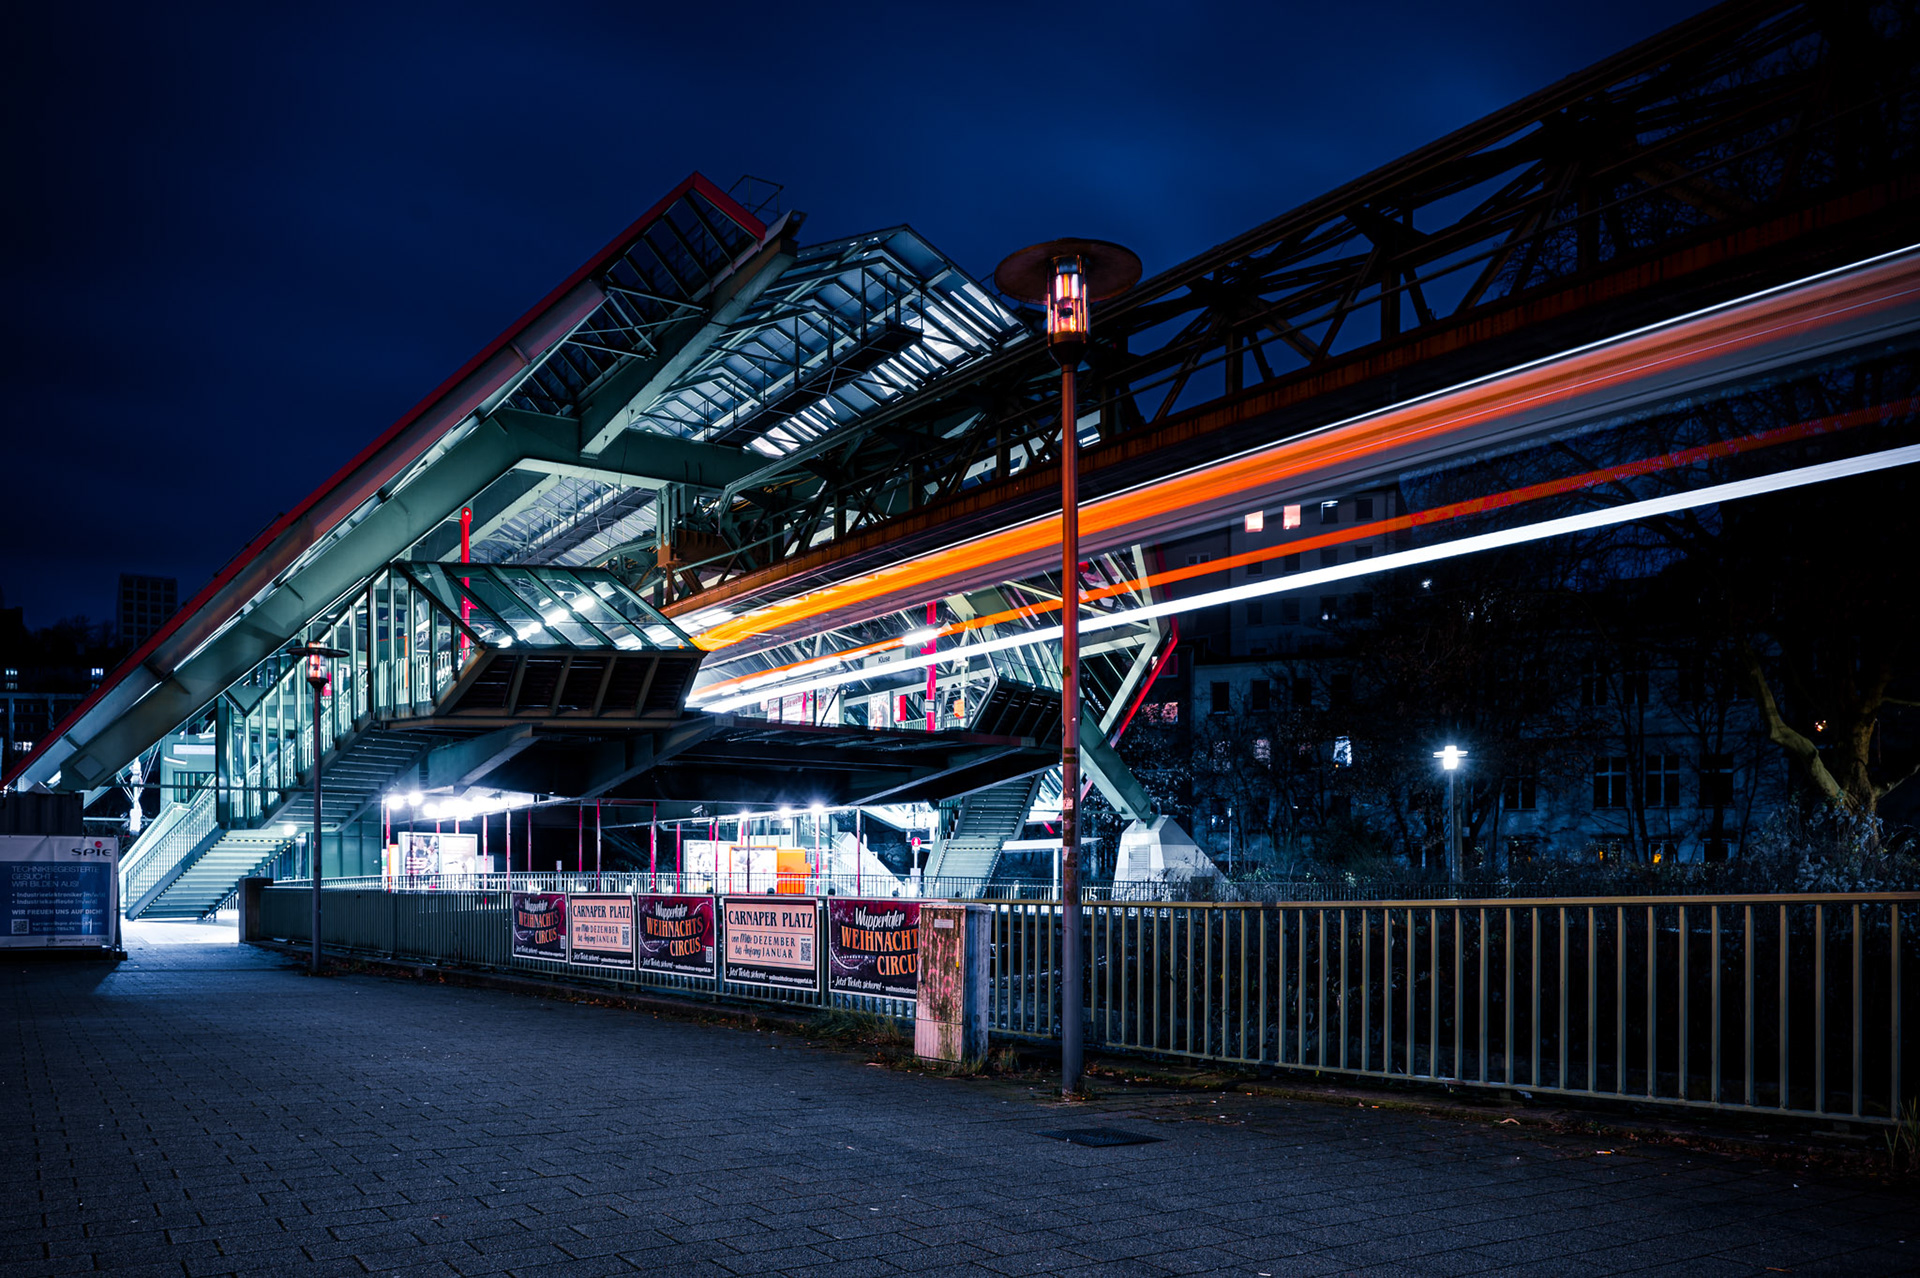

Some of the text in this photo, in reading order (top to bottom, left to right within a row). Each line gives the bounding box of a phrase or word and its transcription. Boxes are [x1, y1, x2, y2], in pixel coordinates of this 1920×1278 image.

[878, 655, 891, 663] Kluse
[72, 847, 112, 857] SPIE
[573, 905, 631, 919] CARNAPER PLATZ
[655, 900, 688, 920] Wuppertaler
[855, 906, 905, 931] Wuppertaler
[518, 910, 559, 928] WEIHNACHTS
[646, 916, 704, 938] WEIHNACHTS
[728, 910, 813, 928] CARNAPER PLATZ
[535, 928, 558, 945] CIRCUS
[590, 925, 619, 934] DEZEMBER
[841, 924, 919, 952] WEIHNACHT
[596, 934, 618, 944] JANUAR
[669, 936, 702, 957] CIRCUS
[753, 935, 796, 947] DEZEMBER
[762, 947, 794, 958] JANUAR
[876, 953, 919, 976] CIRCU
[847, 976, 862, 989] Tickets
